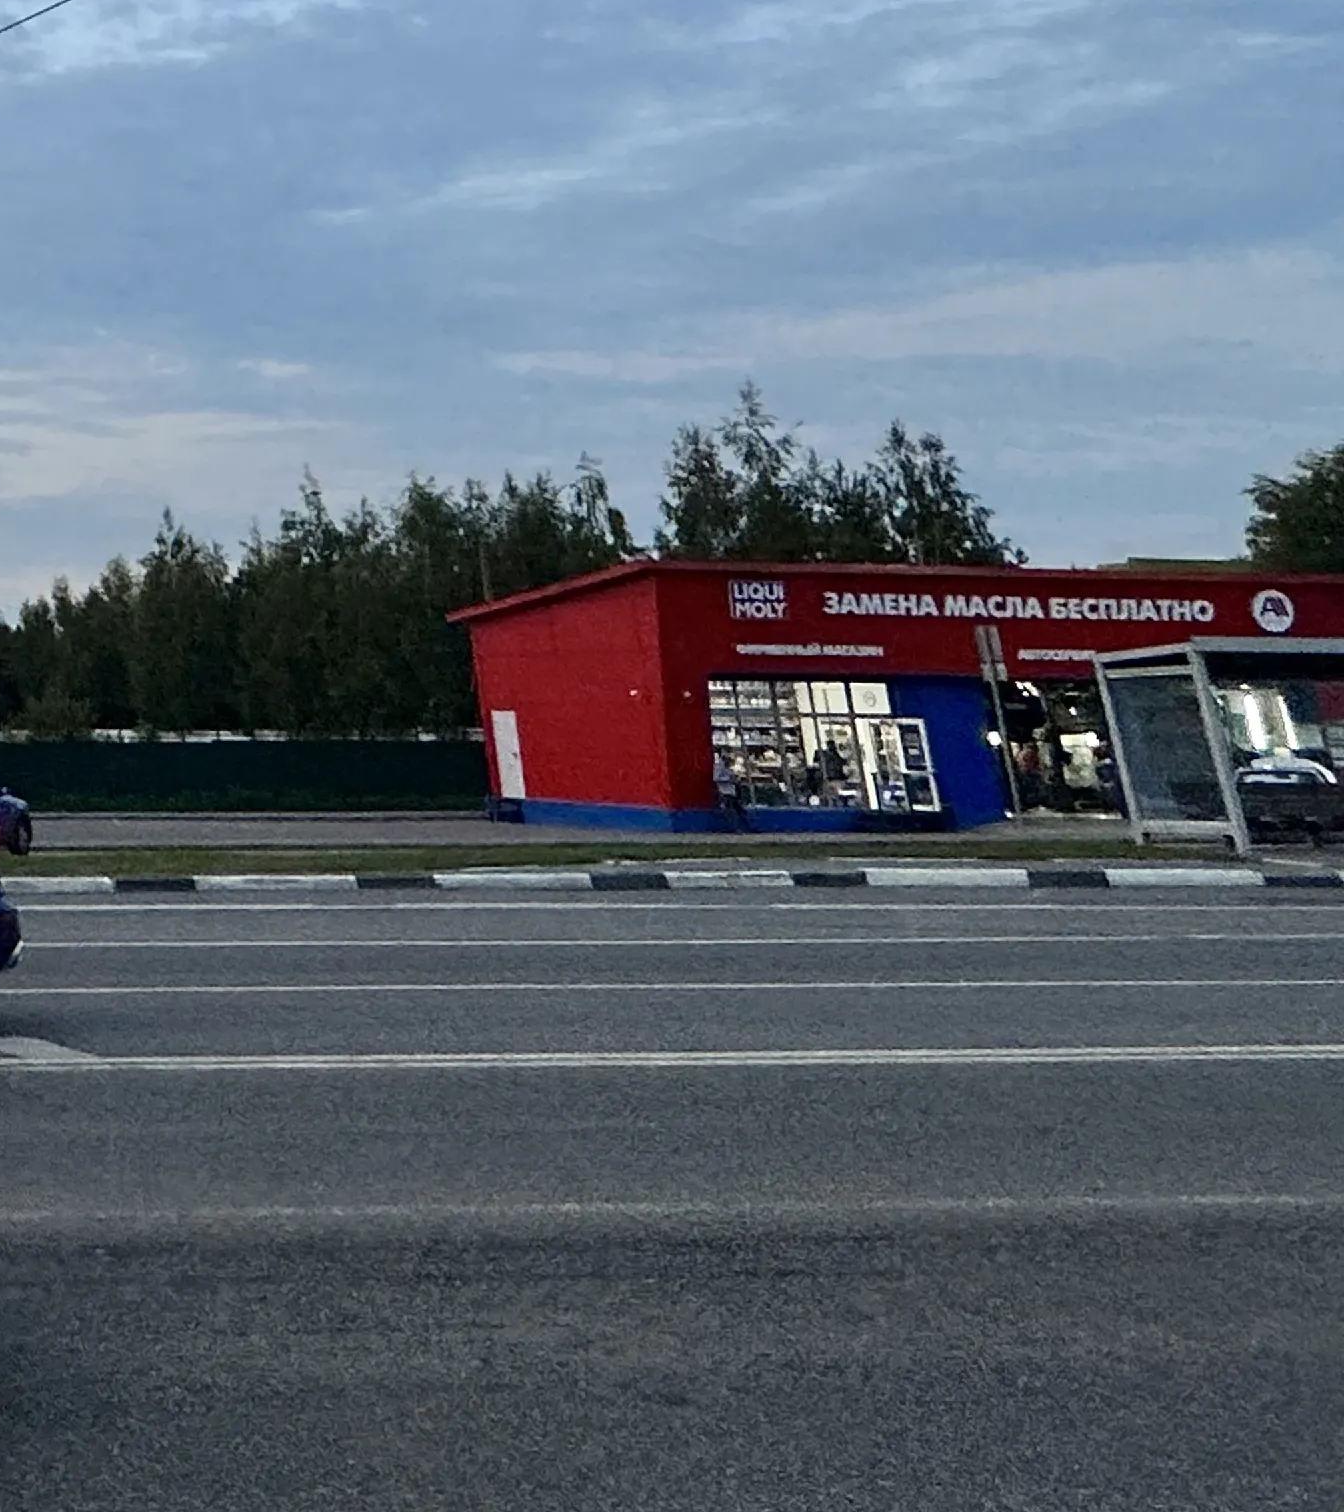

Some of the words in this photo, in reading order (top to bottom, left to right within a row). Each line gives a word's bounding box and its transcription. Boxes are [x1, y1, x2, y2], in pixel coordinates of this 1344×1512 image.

[733, 582, 785, 600] LIQUI
[734, 601, 788, 618] MOLY
[822, 591, 936, 619] ЗАМЕНА
[943, 593, 1044, 620] МАСЛА
[1048, 597, 1215, 623] БЕСПЛАТНО
